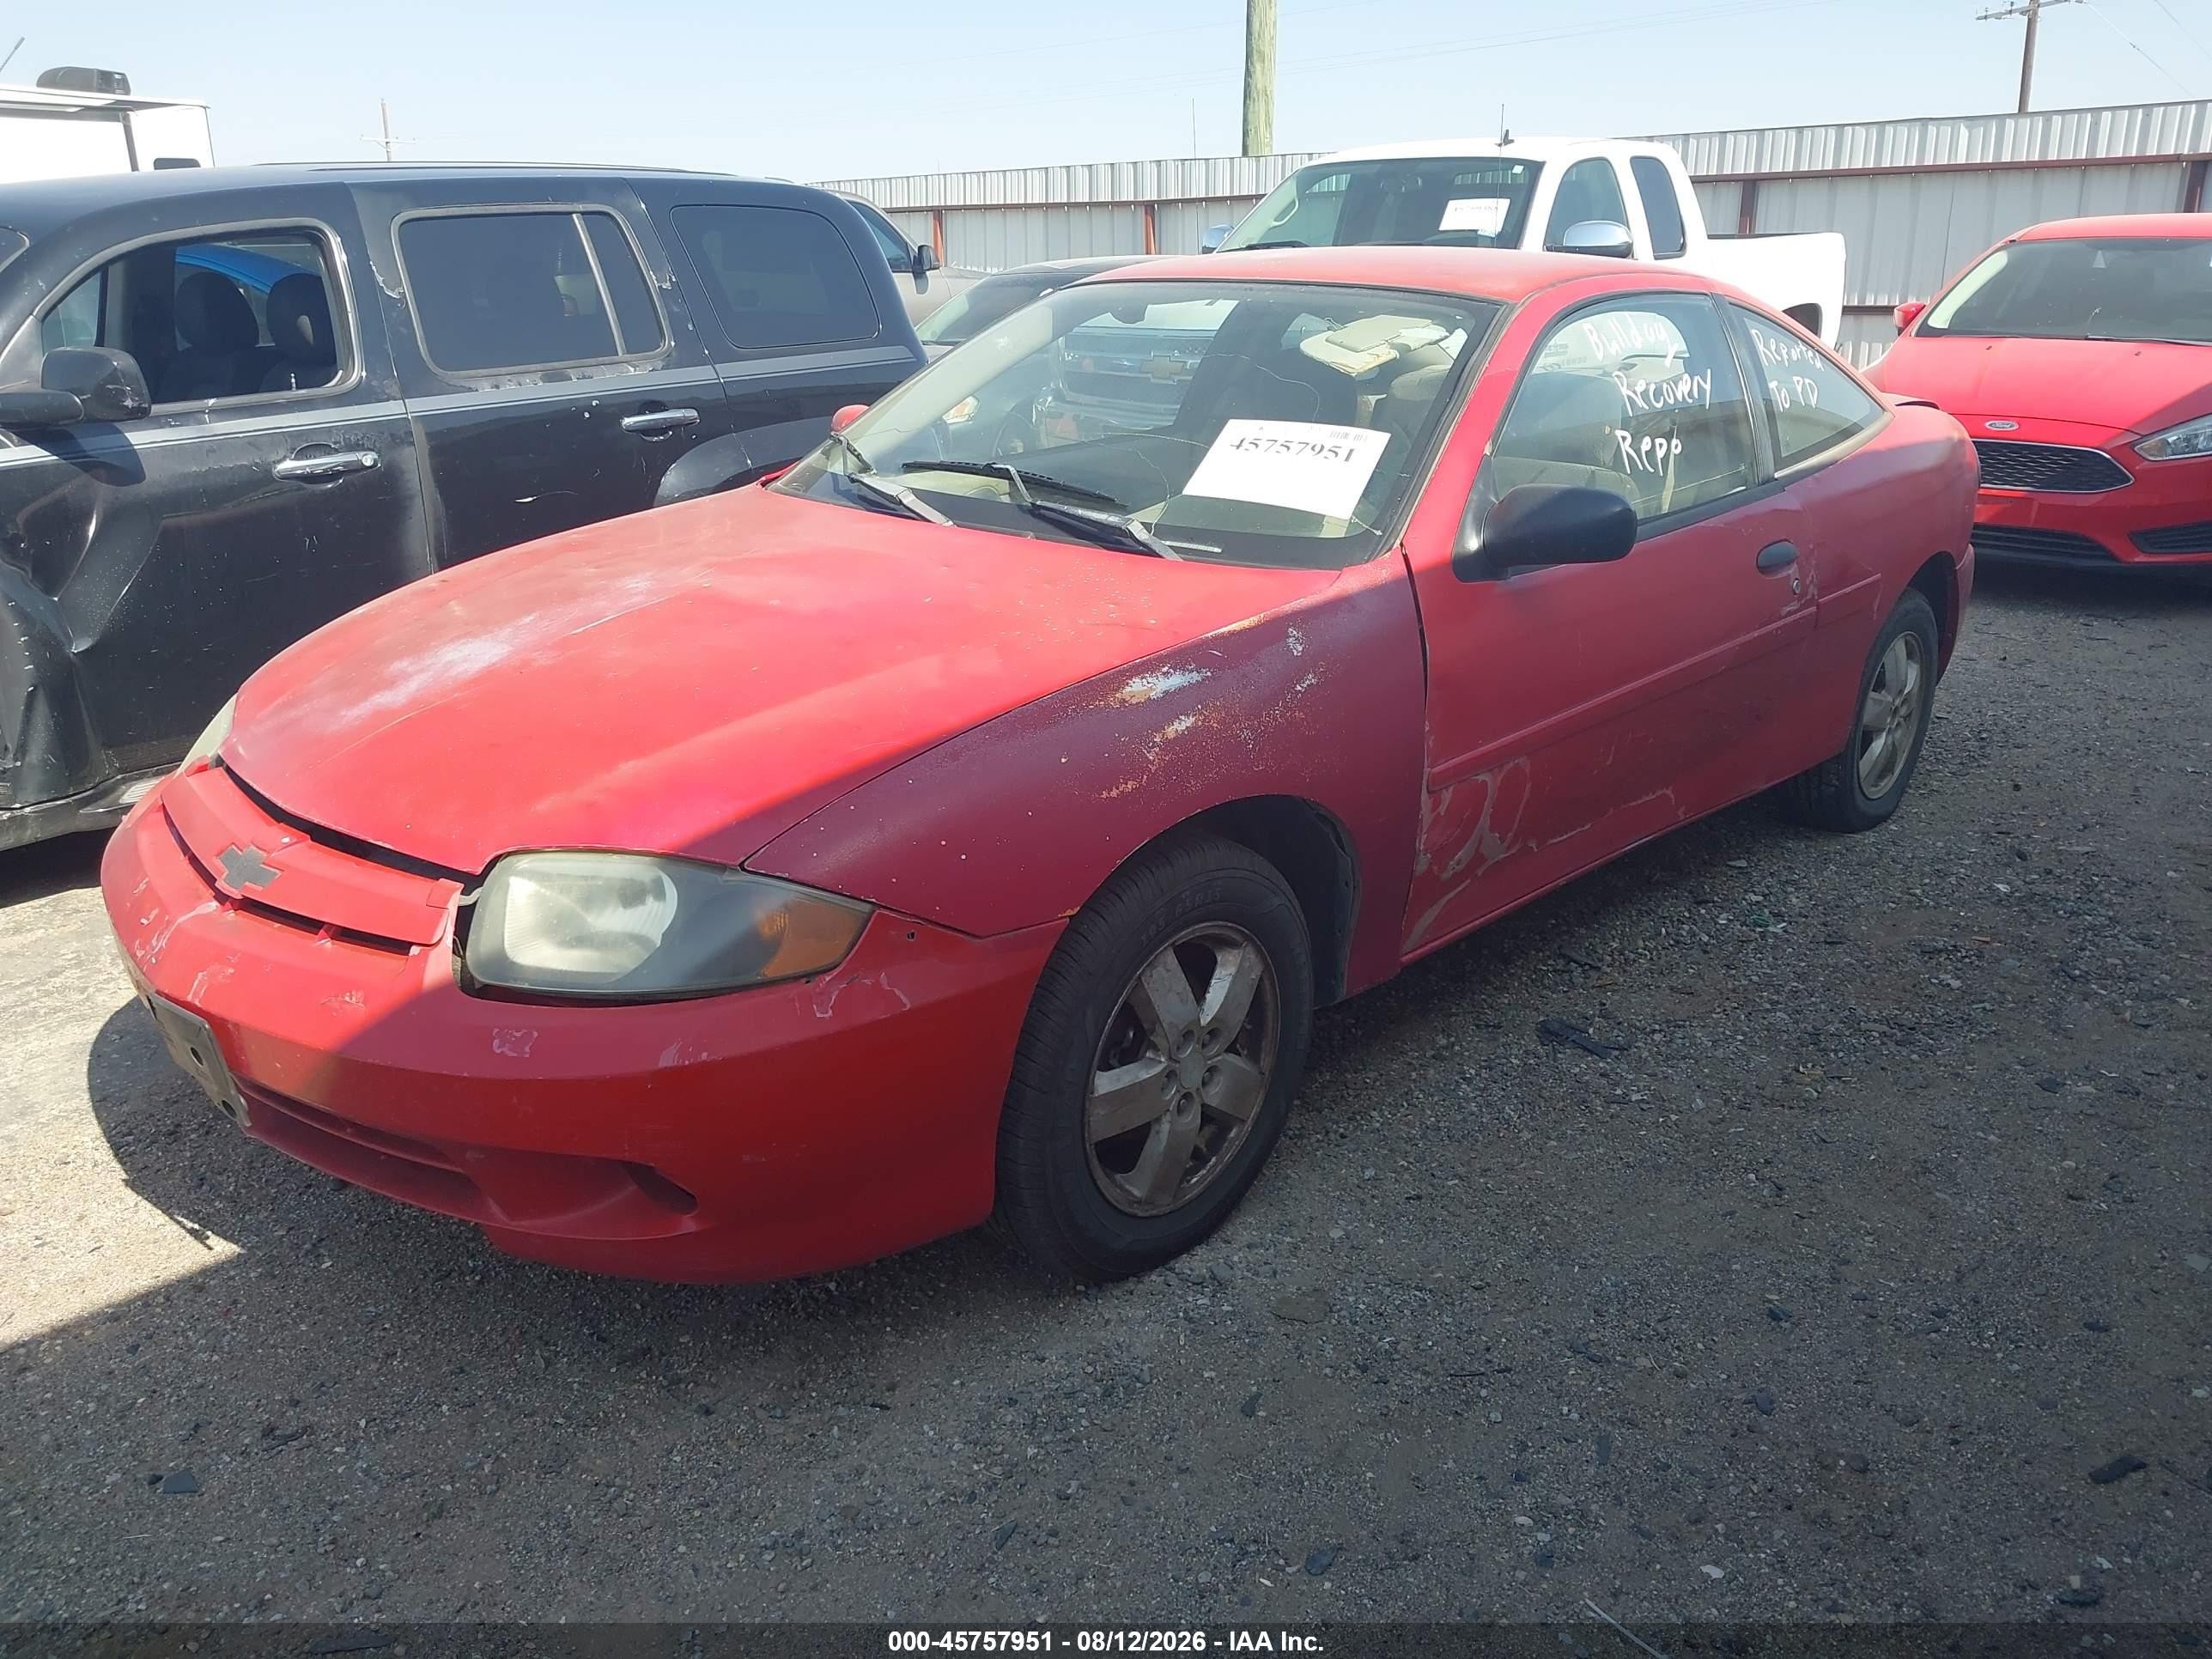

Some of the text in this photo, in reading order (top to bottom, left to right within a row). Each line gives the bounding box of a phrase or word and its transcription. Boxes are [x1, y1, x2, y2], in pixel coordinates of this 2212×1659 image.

[1751, 329, 1825, 371] Reported
[1612, 368, 1711, 417] Recovery
[1769, 375, 1818, 412] To PD
[1230, 437, 1355, 462] 45757951
[1614, 429, 1682, 477] Repo
